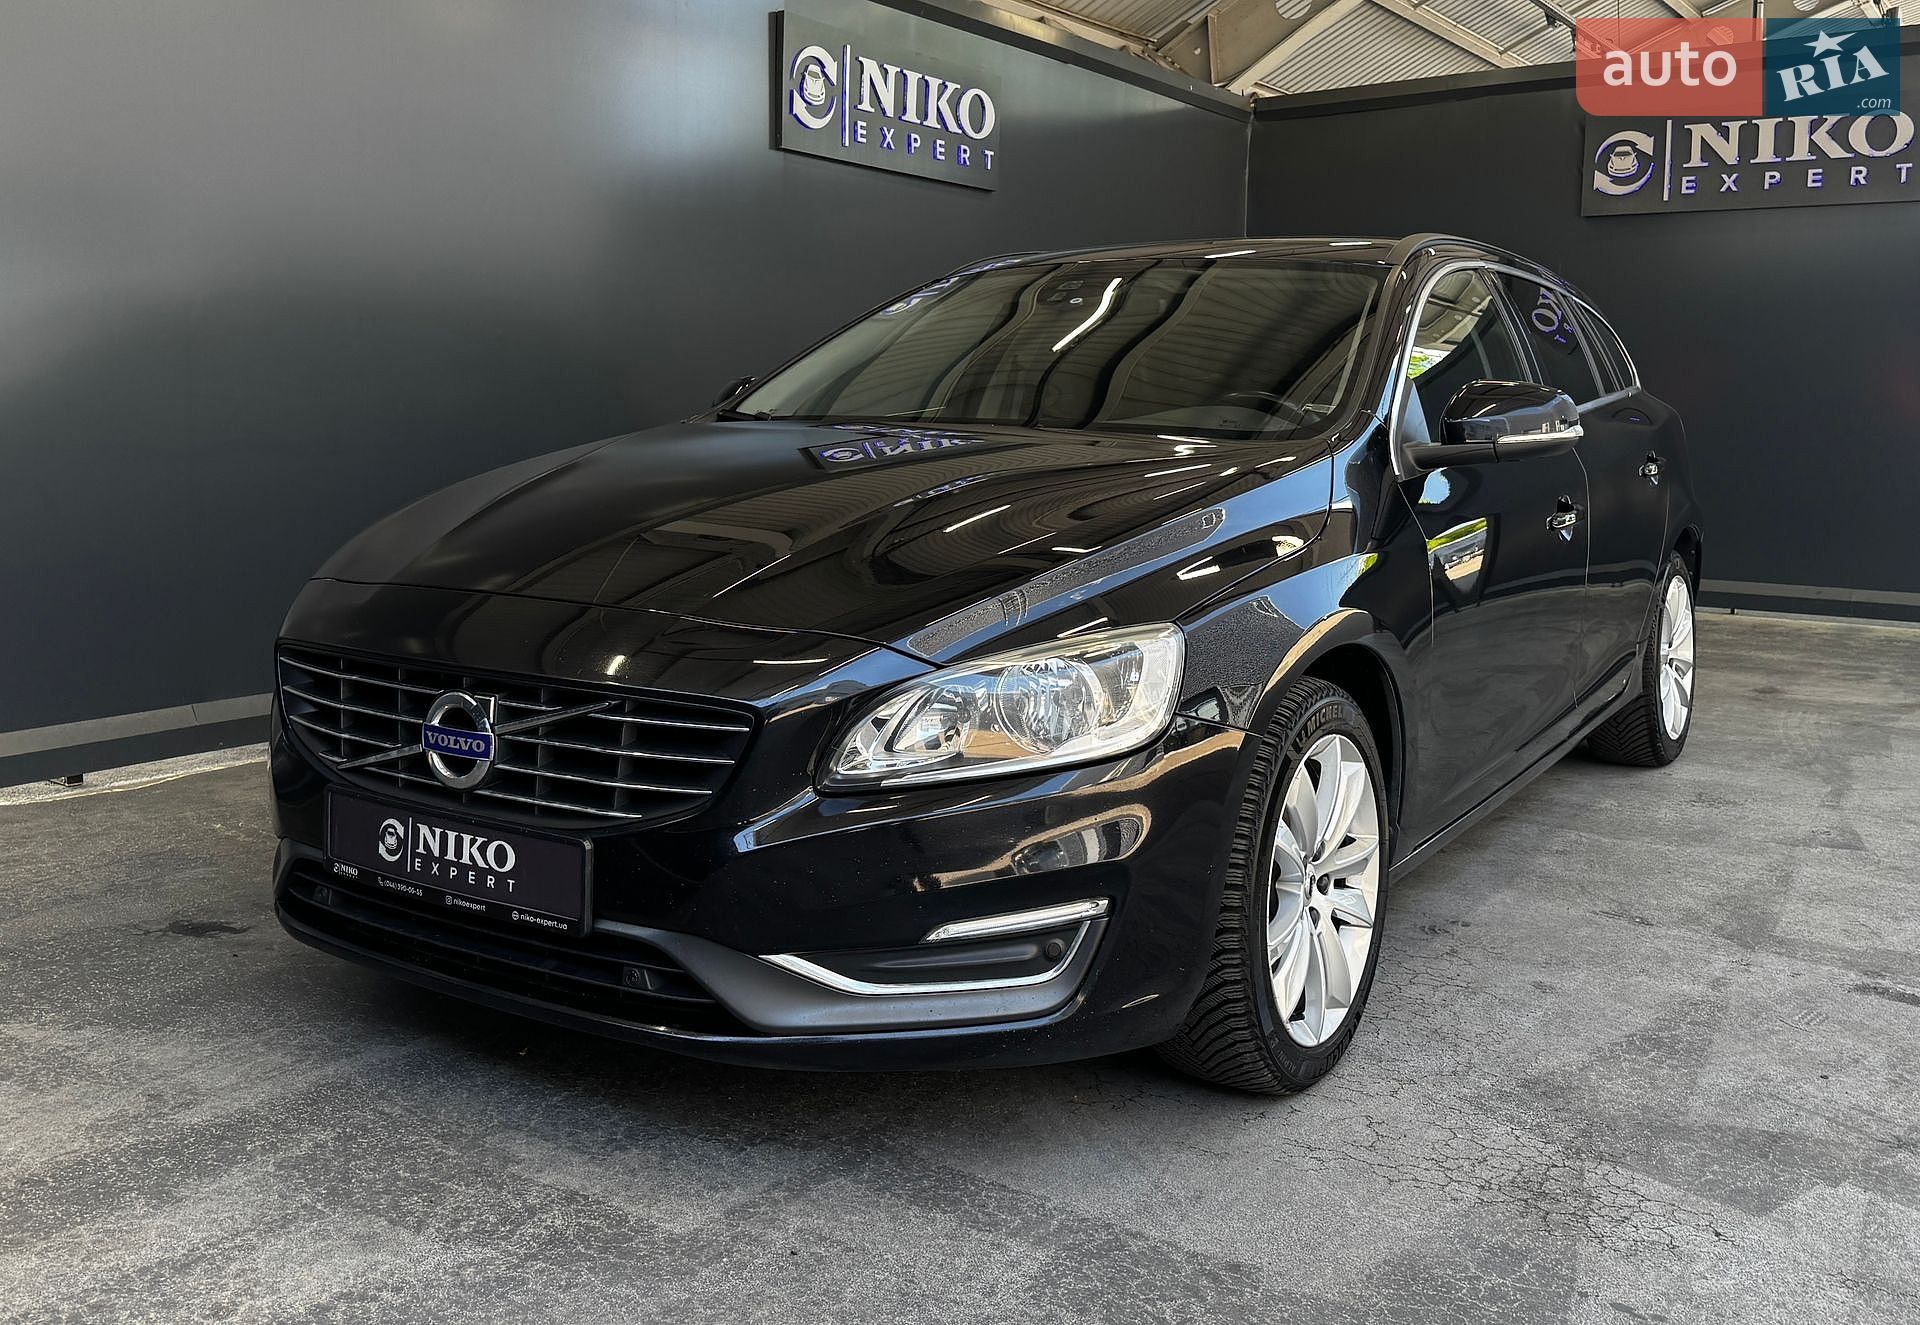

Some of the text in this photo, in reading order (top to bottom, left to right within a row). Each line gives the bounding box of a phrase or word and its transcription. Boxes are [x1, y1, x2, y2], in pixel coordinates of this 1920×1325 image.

[854, 56, 996, 139] NIKO
[854, 121, 994, 170] EXPERT
[1683, 109, 1915, 168] NIKO
[1681, 163, 1913, 195] EXPERT
[426, 730, 485, 753] VOLVO
[415, 823, 516, 873] NIKO
[340, 864, 358, 876] NIKO
[414, 858, 515, 892] EXPERT
[520, 913, 568, 930] niko-expert.ua
